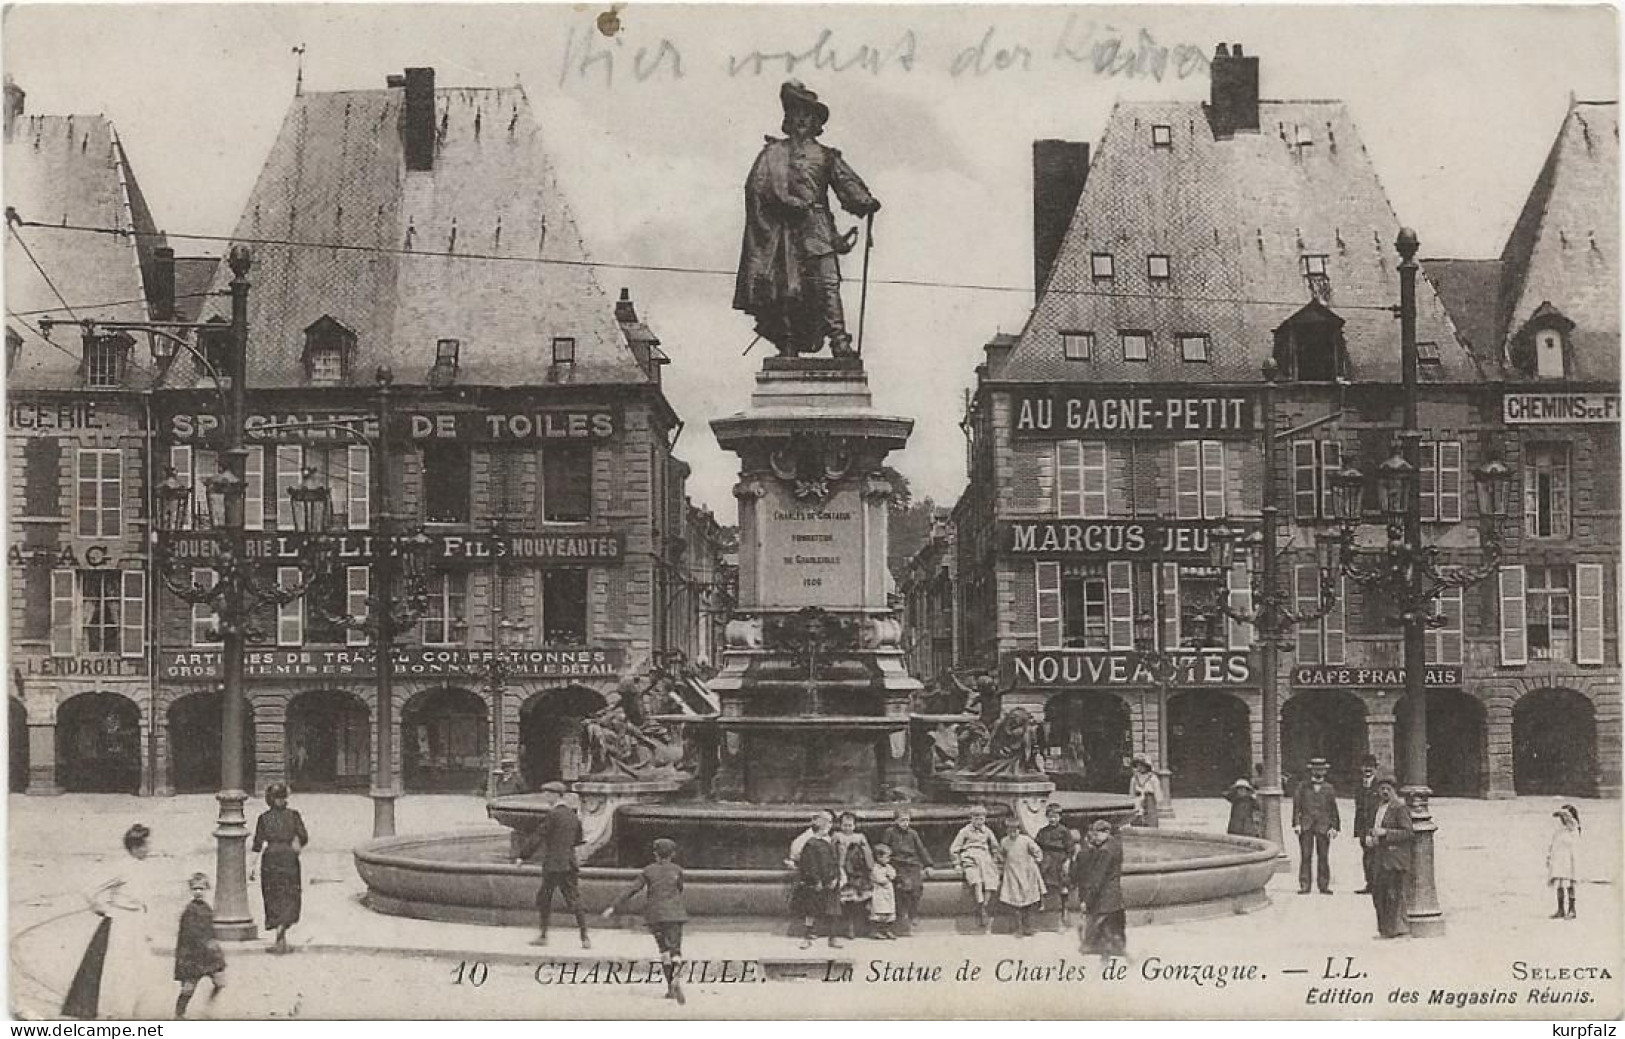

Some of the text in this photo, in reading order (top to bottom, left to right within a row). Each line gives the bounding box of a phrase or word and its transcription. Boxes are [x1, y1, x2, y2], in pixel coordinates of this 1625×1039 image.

[1018, 399, 1246, 430] AU GAGNE-PETIT
[1507, 396, 1586, 419] CHEMINS
[412, 414, 457, 439] DE
[485, 414, 614, 439] TOILES
[1012, 525, 1245, 552] MARCUS JEUE
[175, 652, 274, 665] ARTIES
[286, 652, 311, 664] DE
[244, 663, 352, 676] HEMISES
[1358, 669, 1457, 684] FRANAIS
